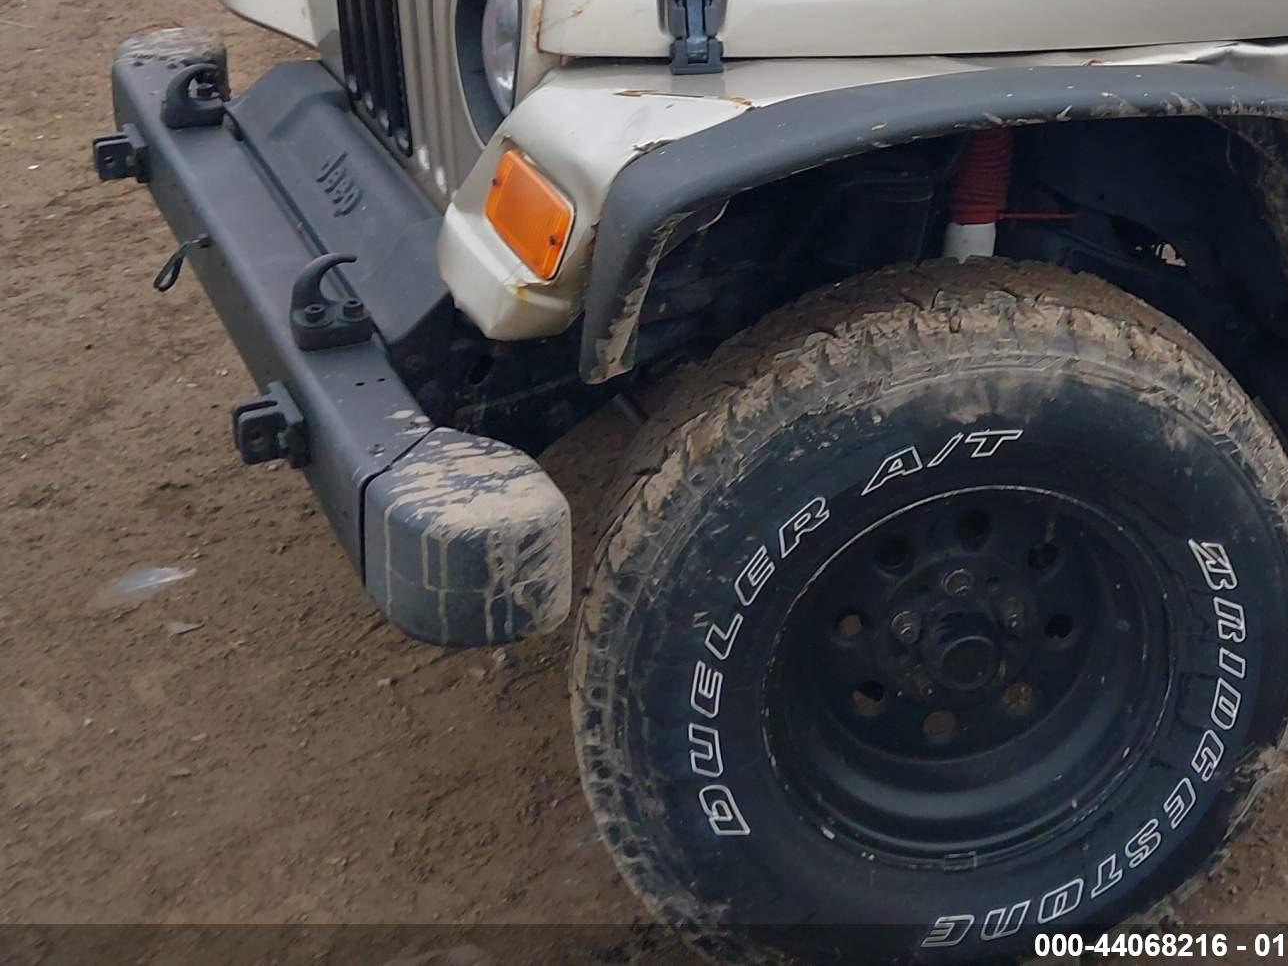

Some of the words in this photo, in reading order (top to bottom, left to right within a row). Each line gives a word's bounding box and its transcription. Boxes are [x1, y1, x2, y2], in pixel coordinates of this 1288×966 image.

[316, 151, 364, 218] Jeep
[688, 496, 830, 836] DUELER
[860, 428, 1024, 496] A/T
[919, 537, 1247, 949] BRIDGESTONE
